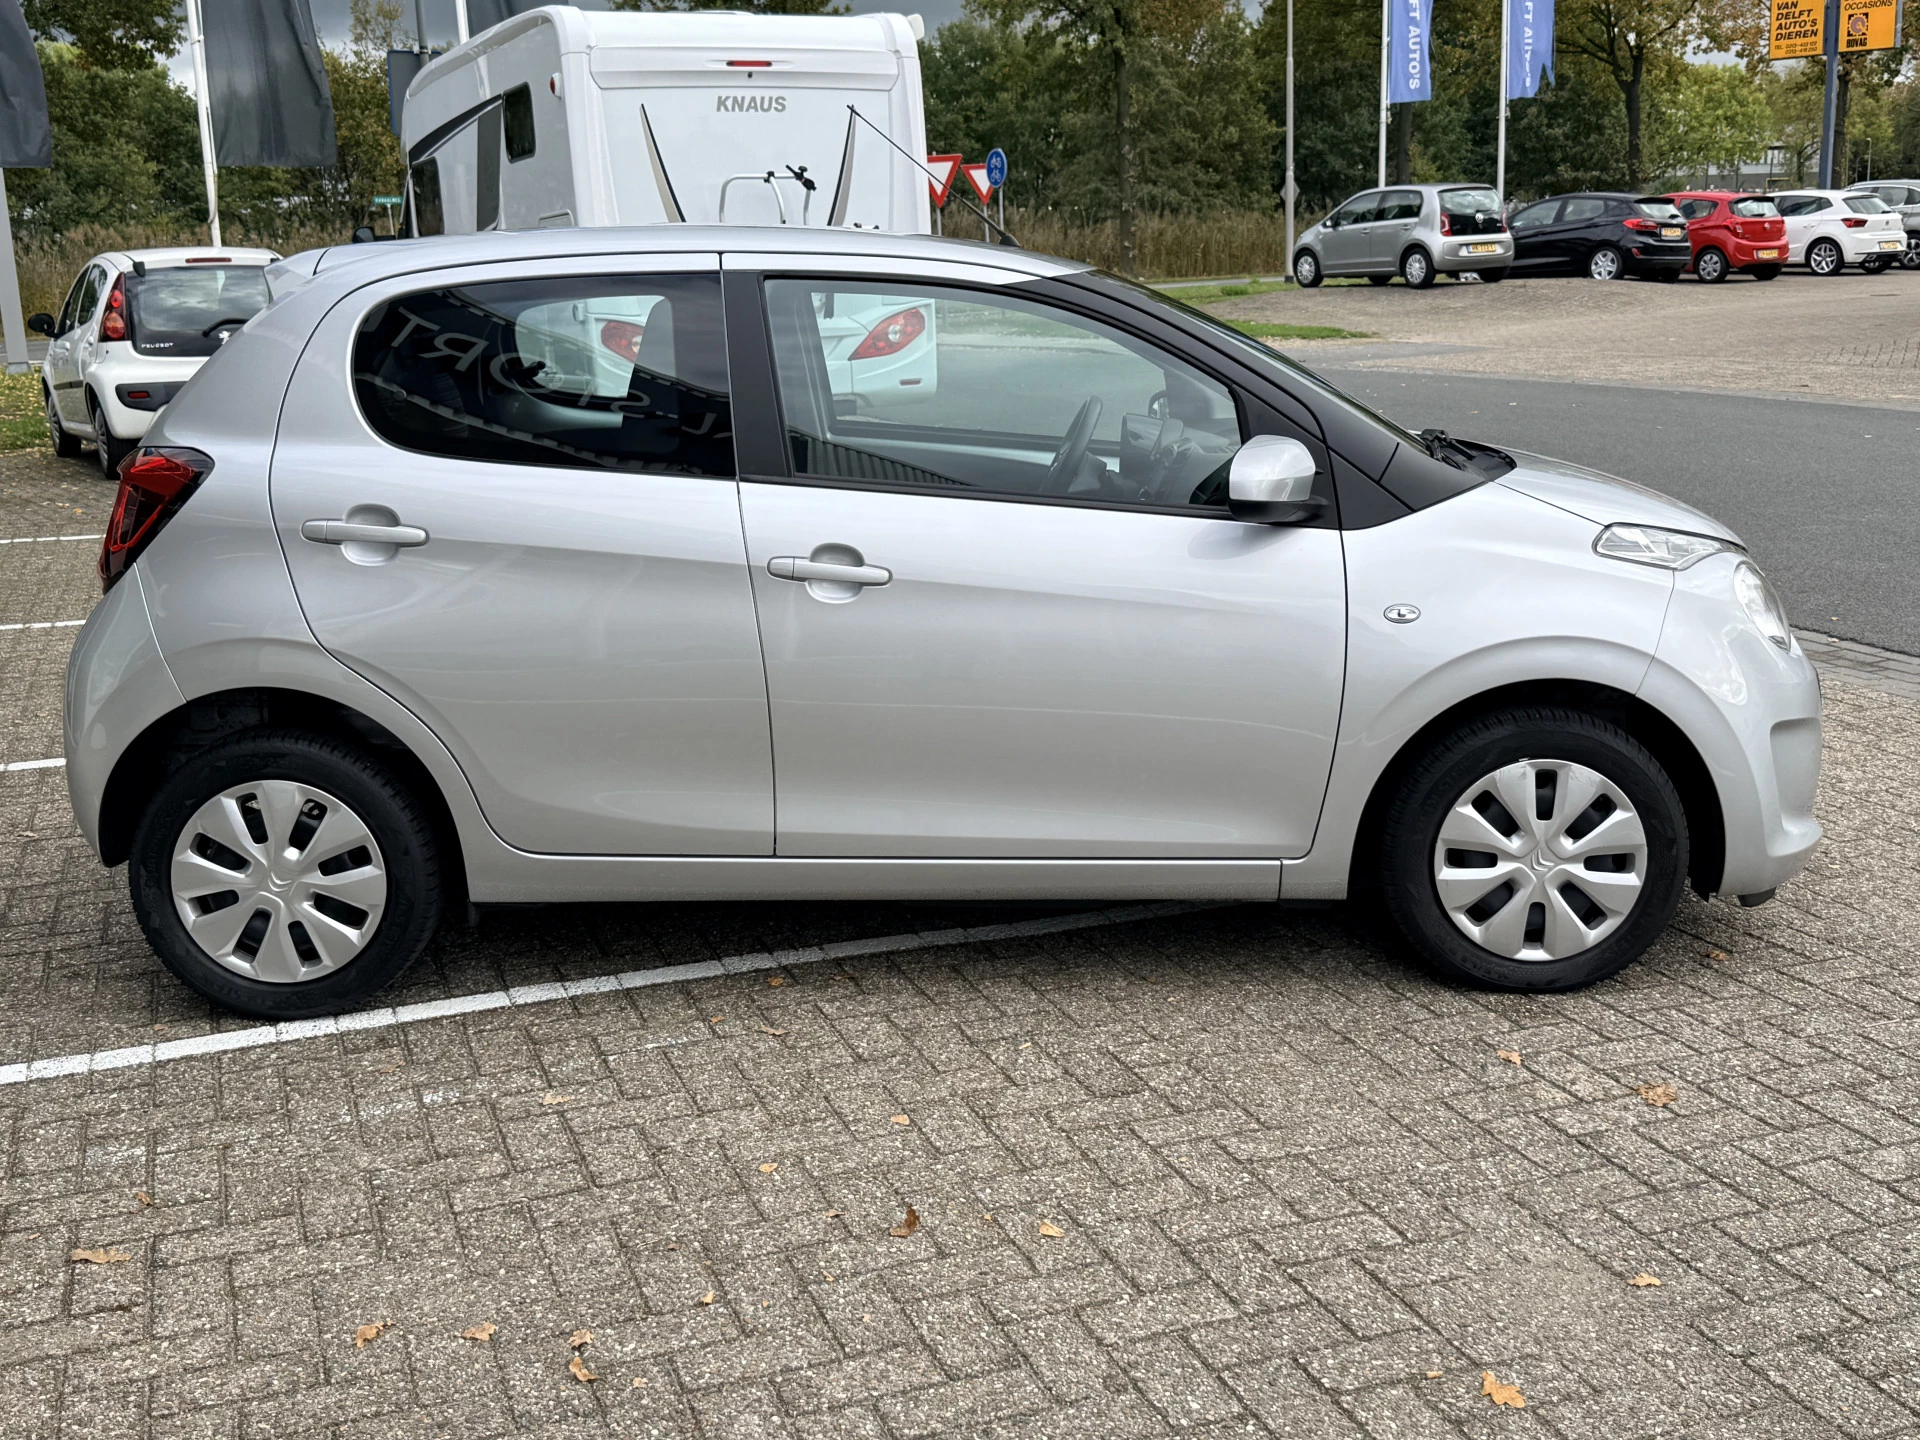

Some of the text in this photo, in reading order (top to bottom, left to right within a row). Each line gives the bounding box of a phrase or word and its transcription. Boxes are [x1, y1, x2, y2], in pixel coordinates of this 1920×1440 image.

[1524, 0, 1533, 23] FT
[1776, 1, 1799, 11] VAN
[1844, 0, 1894, 11] OCCASIONS
[1775, 9, 1813, 21] DELFT
[1775, 18, 1818, 31] AUTO'S
[1774, 28, 1819, 41] DIEREN
[1846, 37, 1868, 48] BOVAG
[1408, 25, 1421, 90] AUTO'S
[716, 95, 787, 113] KNAUS
